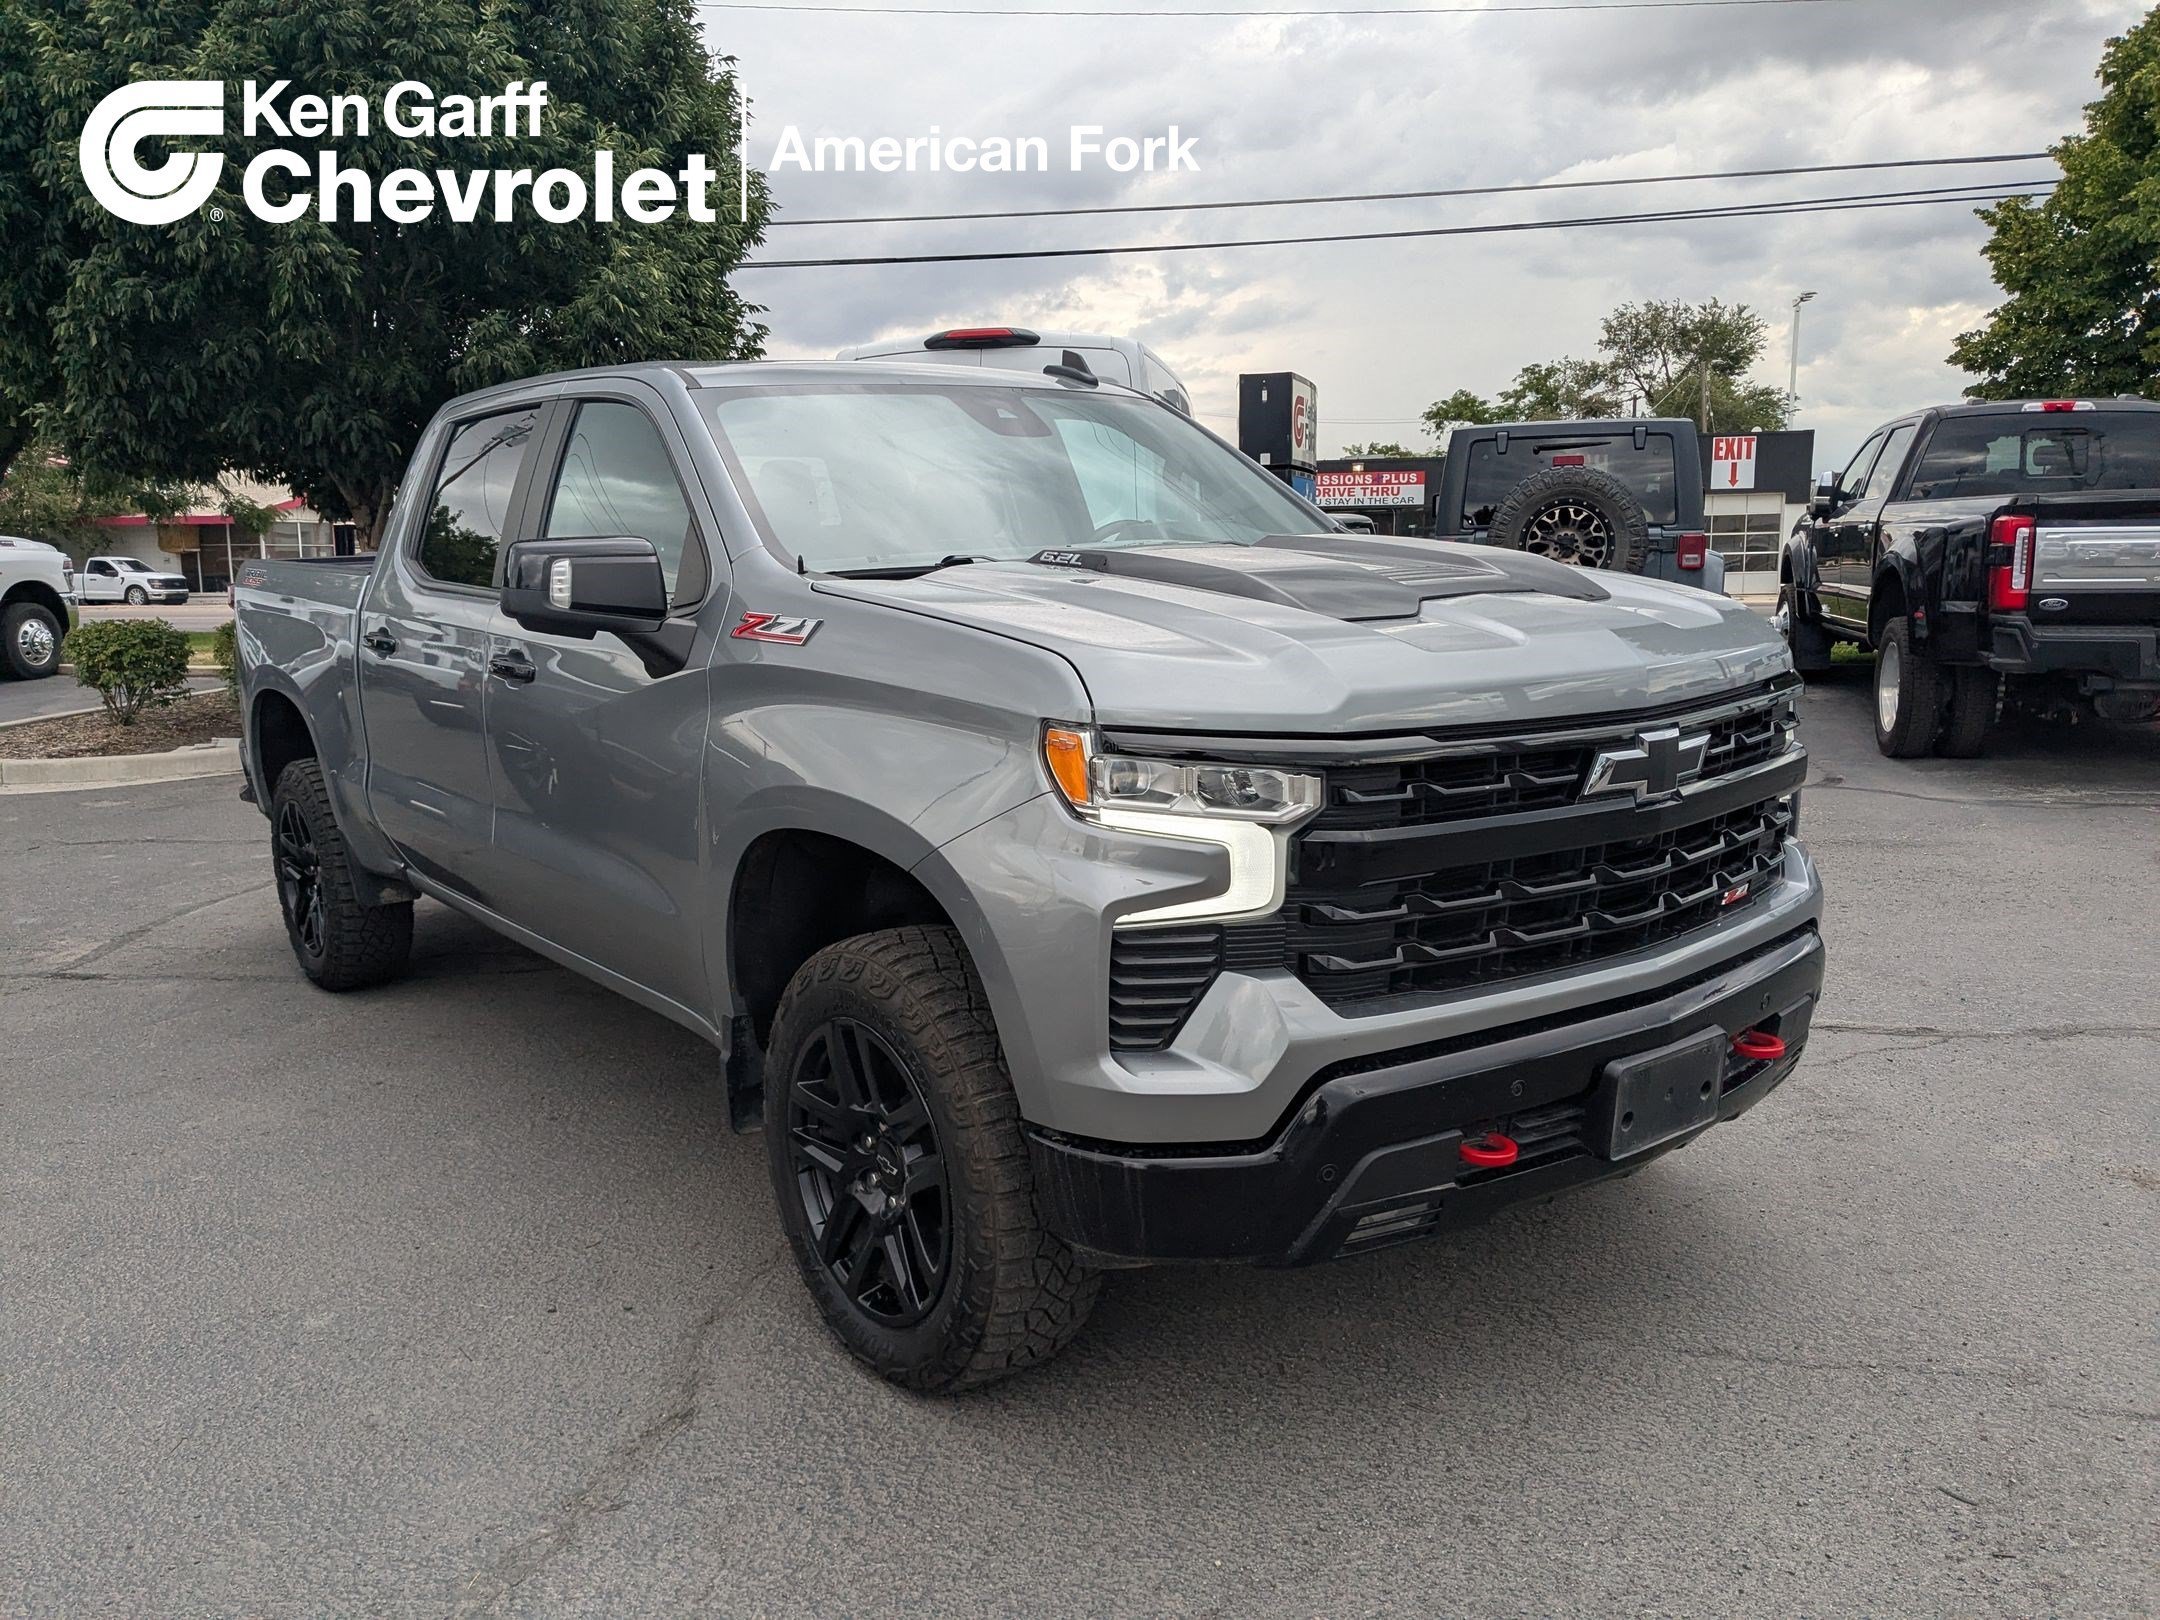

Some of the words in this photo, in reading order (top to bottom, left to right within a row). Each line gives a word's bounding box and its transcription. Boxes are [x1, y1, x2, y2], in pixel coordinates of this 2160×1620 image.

[1713, 437, 1755, 460] EXIT
[1382, 473, 1417, 483] PLUS
[1361, 486, 1400, 497] THRU
[1325, 497, 1351, 506] STAY
[1353, 497, 1365, 505] IN
[1367, 497, 1389, 505] THE
[1391, 496, 1415, 504] CAR
[730, 611, 824, 646] Z71
